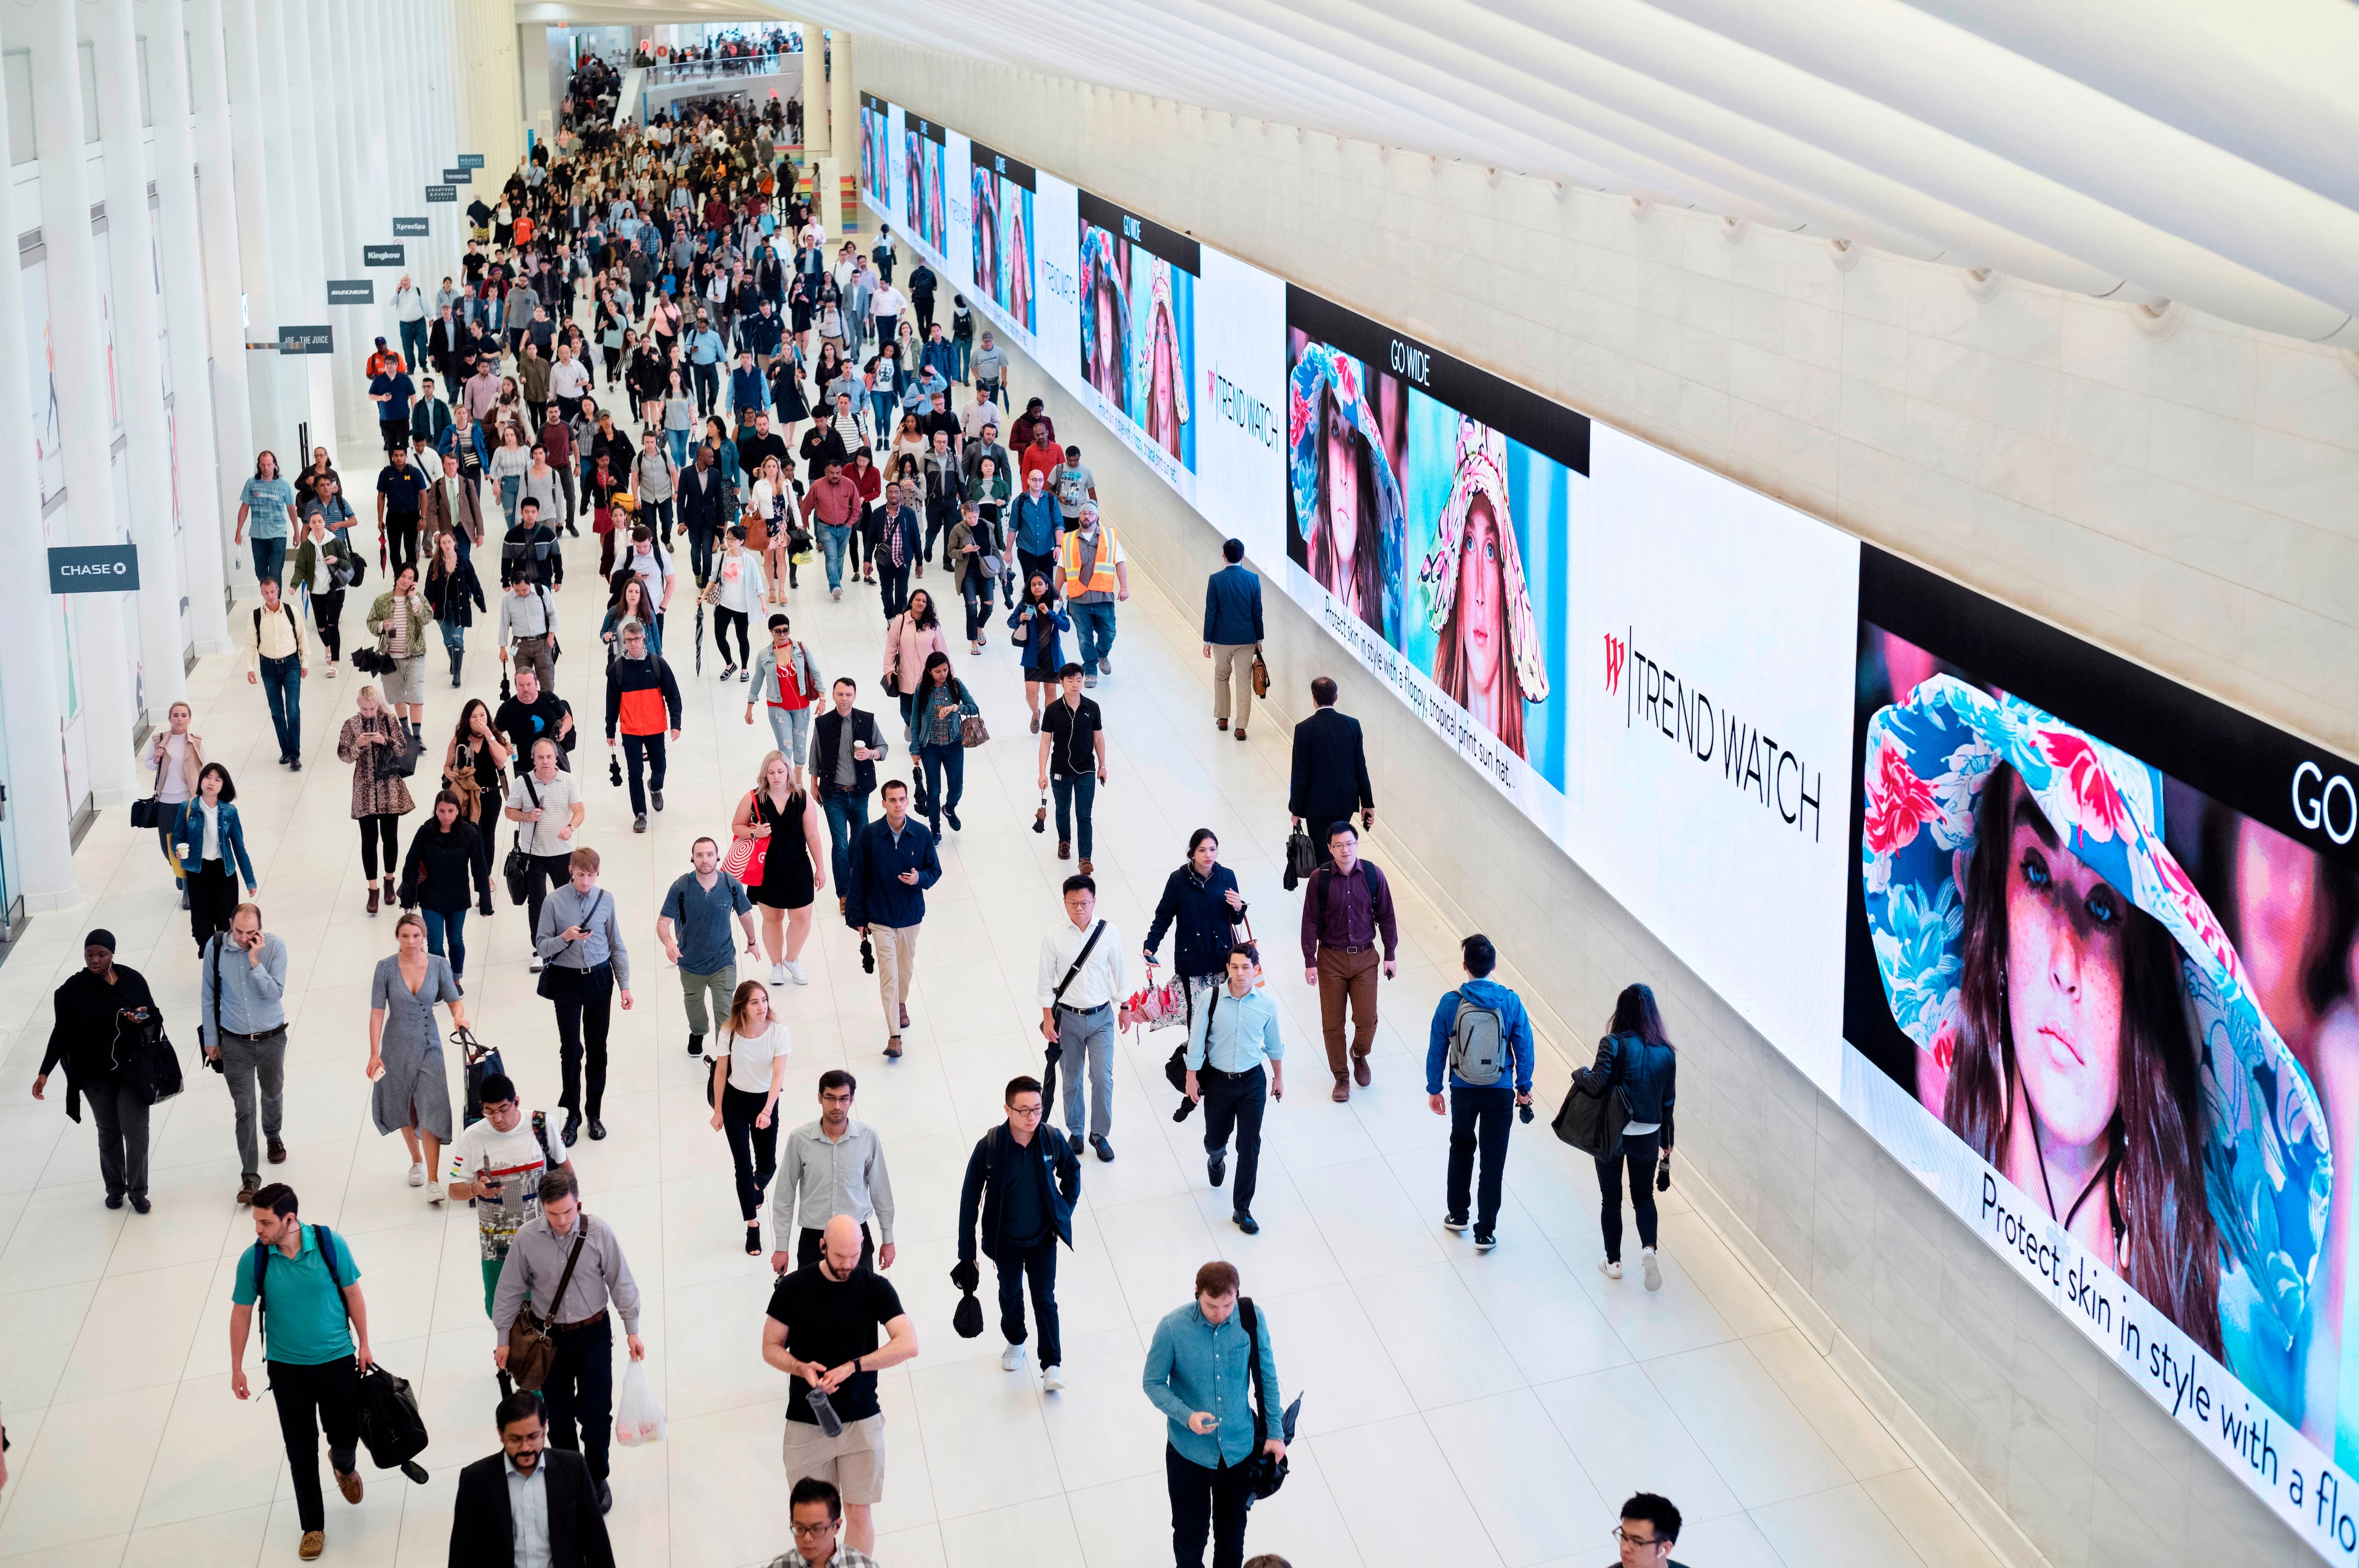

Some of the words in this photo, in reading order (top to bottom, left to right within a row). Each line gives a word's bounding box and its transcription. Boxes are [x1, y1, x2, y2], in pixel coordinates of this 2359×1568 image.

[367, 252, 401, 260] Kingkow
[312, 335, 329, 344] JUICE
[1391, 338, 1406, 374] GO
[1406, 345, 1431, 387] WIDE
[1218, 375, 1245, 428] TREND
[1246, 394, 1278, 453] WATCH
[61, 564, 111, 576] CHASE
[1325, 595, 1347, 638] Protect
[1347, 617, 1359, 649] skin
[1360, 626, 1366, 656] in
[1367, 640, 1382, 676] style
[1383, 651, 1397, 685] with
[1399, 671, 1402, 688] a
[1404, 665, 1428, 721] floppy,
[1430, 693, 1456, 738] tropical
[1458, 719, 1477, 755] print
[1479, 743, 1493, 771] sun
[1634, 650, 1714, 762] TREND
[1722, 708, 1821, 843] WATCH
[2291, 760, 2358, 845] GO
[1982, 1171, 2060, 1287] Protect
[2068, 1257, 2111, 1333] skin
[2120, 1295, 2140, 1360] in
[2150, 1343, 2210, 1422] style
[2221, 1402, 2278, 1485] with
[2289, 1469, 2304, 1509] a
